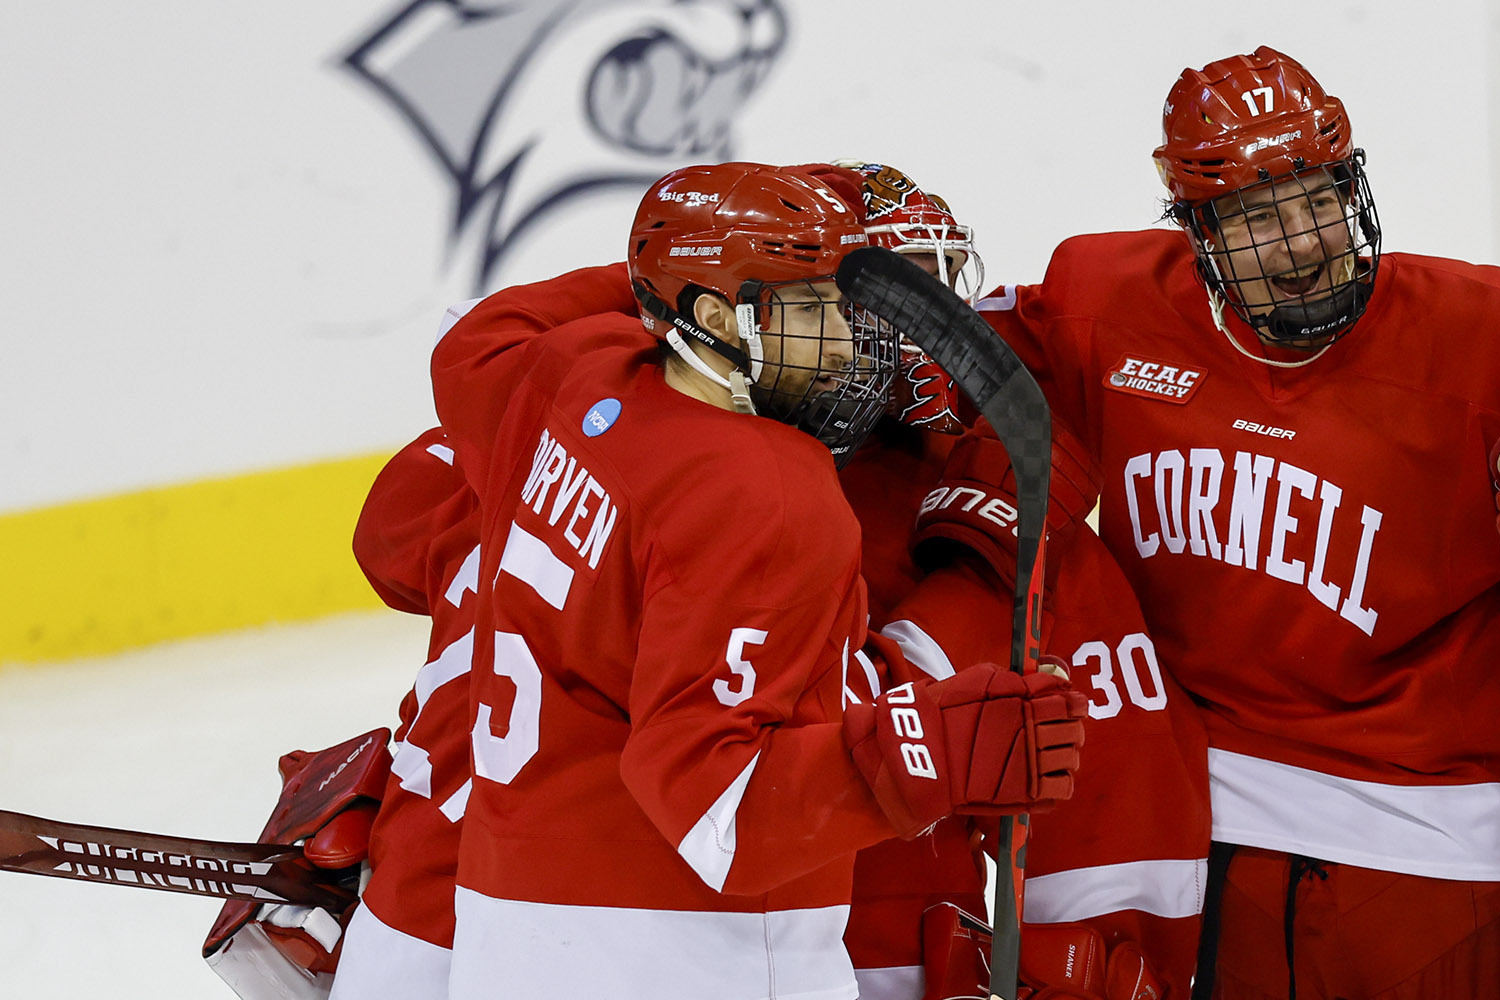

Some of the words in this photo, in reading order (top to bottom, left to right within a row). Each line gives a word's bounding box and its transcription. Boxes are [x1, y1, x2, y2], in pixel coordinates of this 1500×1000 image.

[1241, 86, 1275, 118] 17
[660, 191, 686, 205] Big
[686, 191, 720, 207] Red
[814, 188, 847, 214] 5
[1119, 358, 1200, 388] ECAC
[1125, 376, 1190, 399] HOCKEY
[1124, 448, 1384, 638] CORNELL
[712, 627, 769, 707] 5
[1072, 632, 1168, 721] 30
